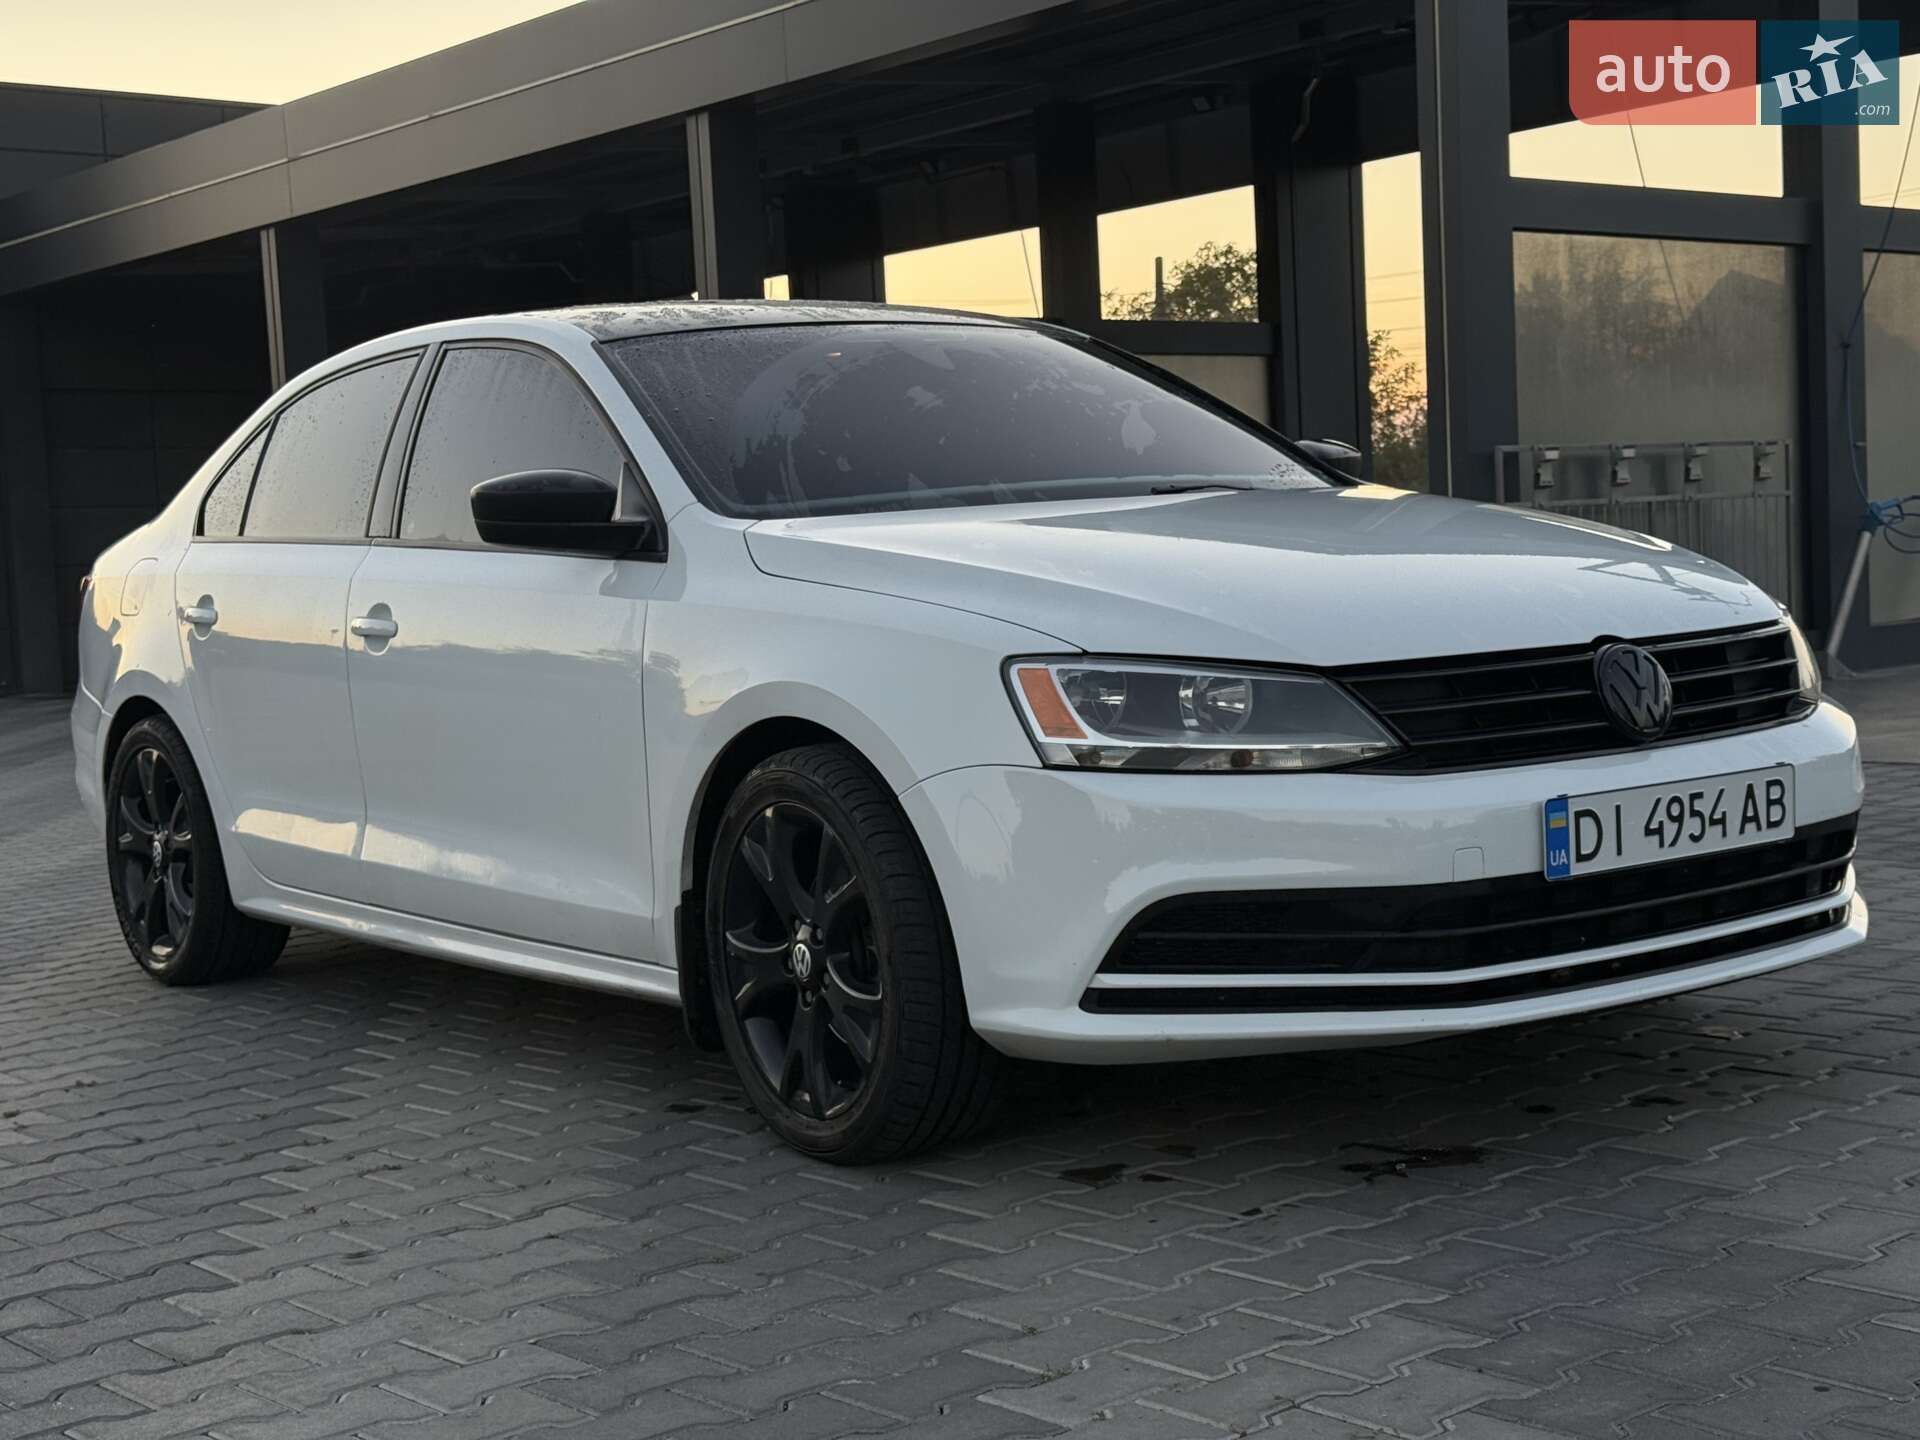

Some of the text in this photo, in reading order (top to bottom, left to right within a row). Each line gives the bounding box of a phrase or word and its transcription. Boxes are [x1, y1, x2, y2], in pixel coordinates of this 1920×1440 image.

[1574, 779, 1786, 863] DI 4954 AB
[1550, 849, 1568, 866] UA
